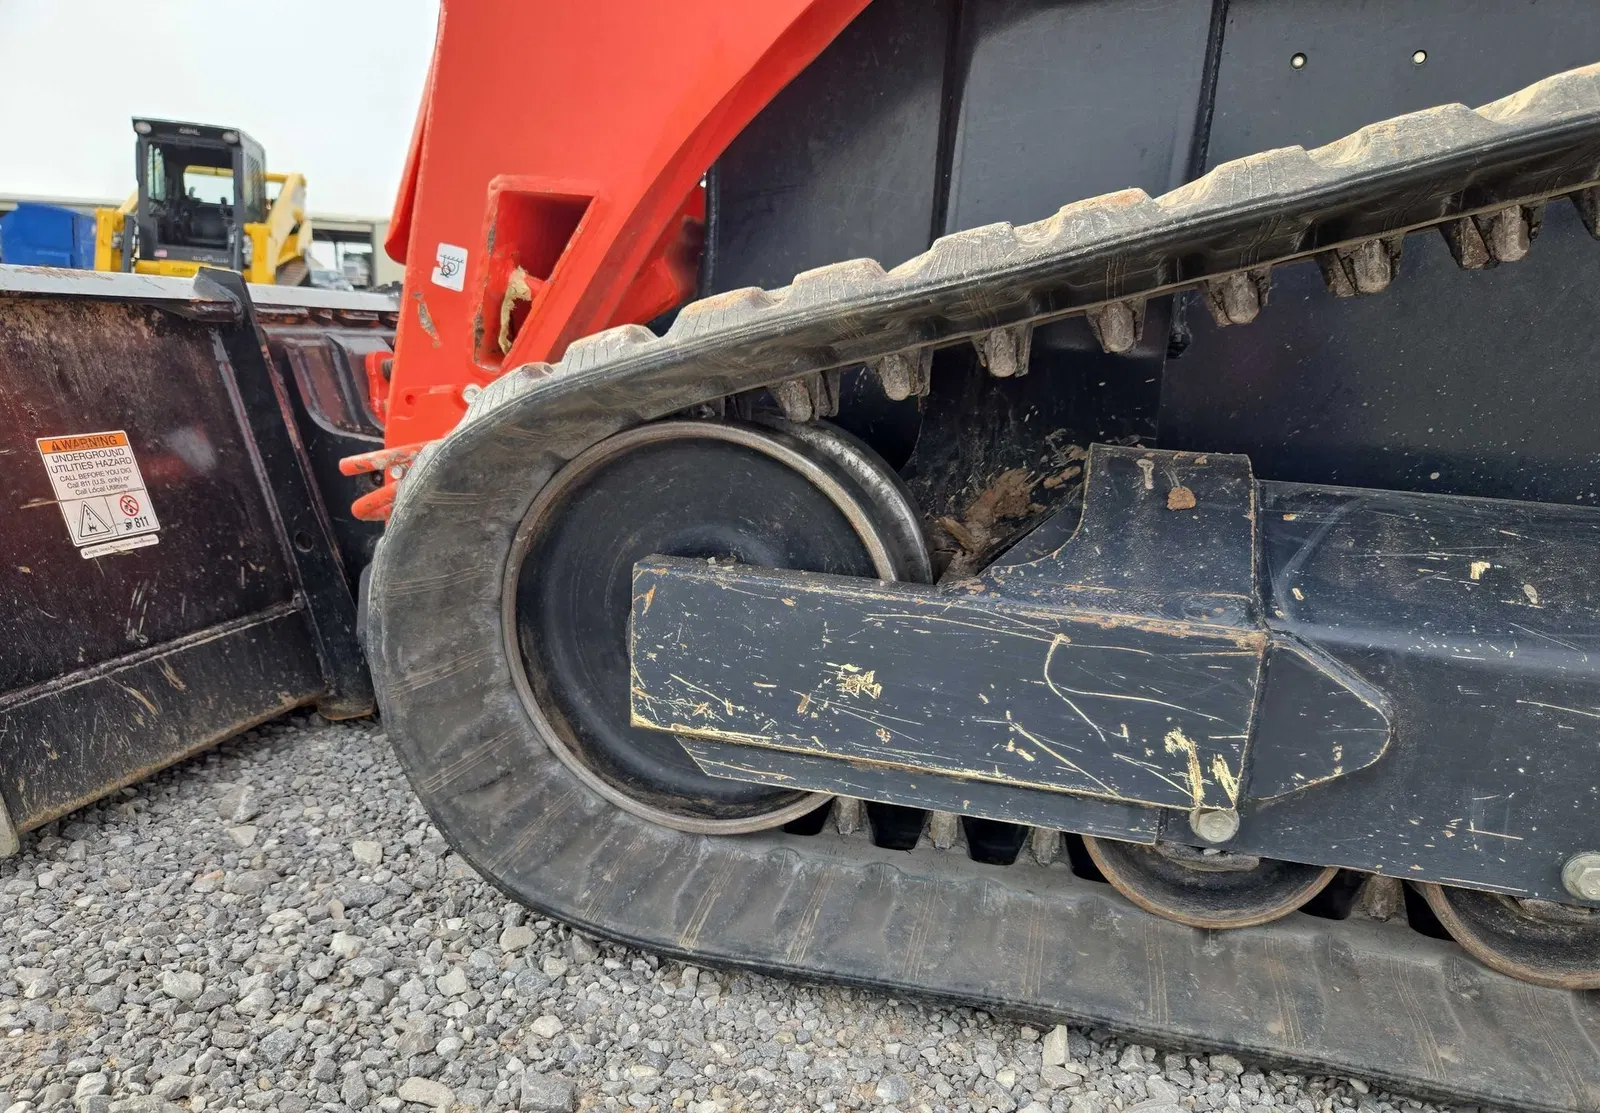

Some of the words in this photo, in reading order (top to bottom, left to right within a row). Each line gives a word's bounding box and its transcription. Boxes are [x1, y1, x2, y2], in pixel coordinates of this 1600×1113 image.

[60, 435, 118, 451] WARNING
[51, 448, 125, 463] UNDERGROUND
[50, 461, 94, 474] UTILITIES
[95, 456, 132, 468] HAZARD
[59, 474, 78, 482] CALL
[78, 470, 105, 480] BEFORE
[105, 468, 120, 476] YOU
[66, 481, 79, 489] Call
[91, 478, 106, 486] (U.S.
[74, 487, 88, 495] Call
[88, 485, 106, 493] Local
[134, 516, 150, 528] 811
